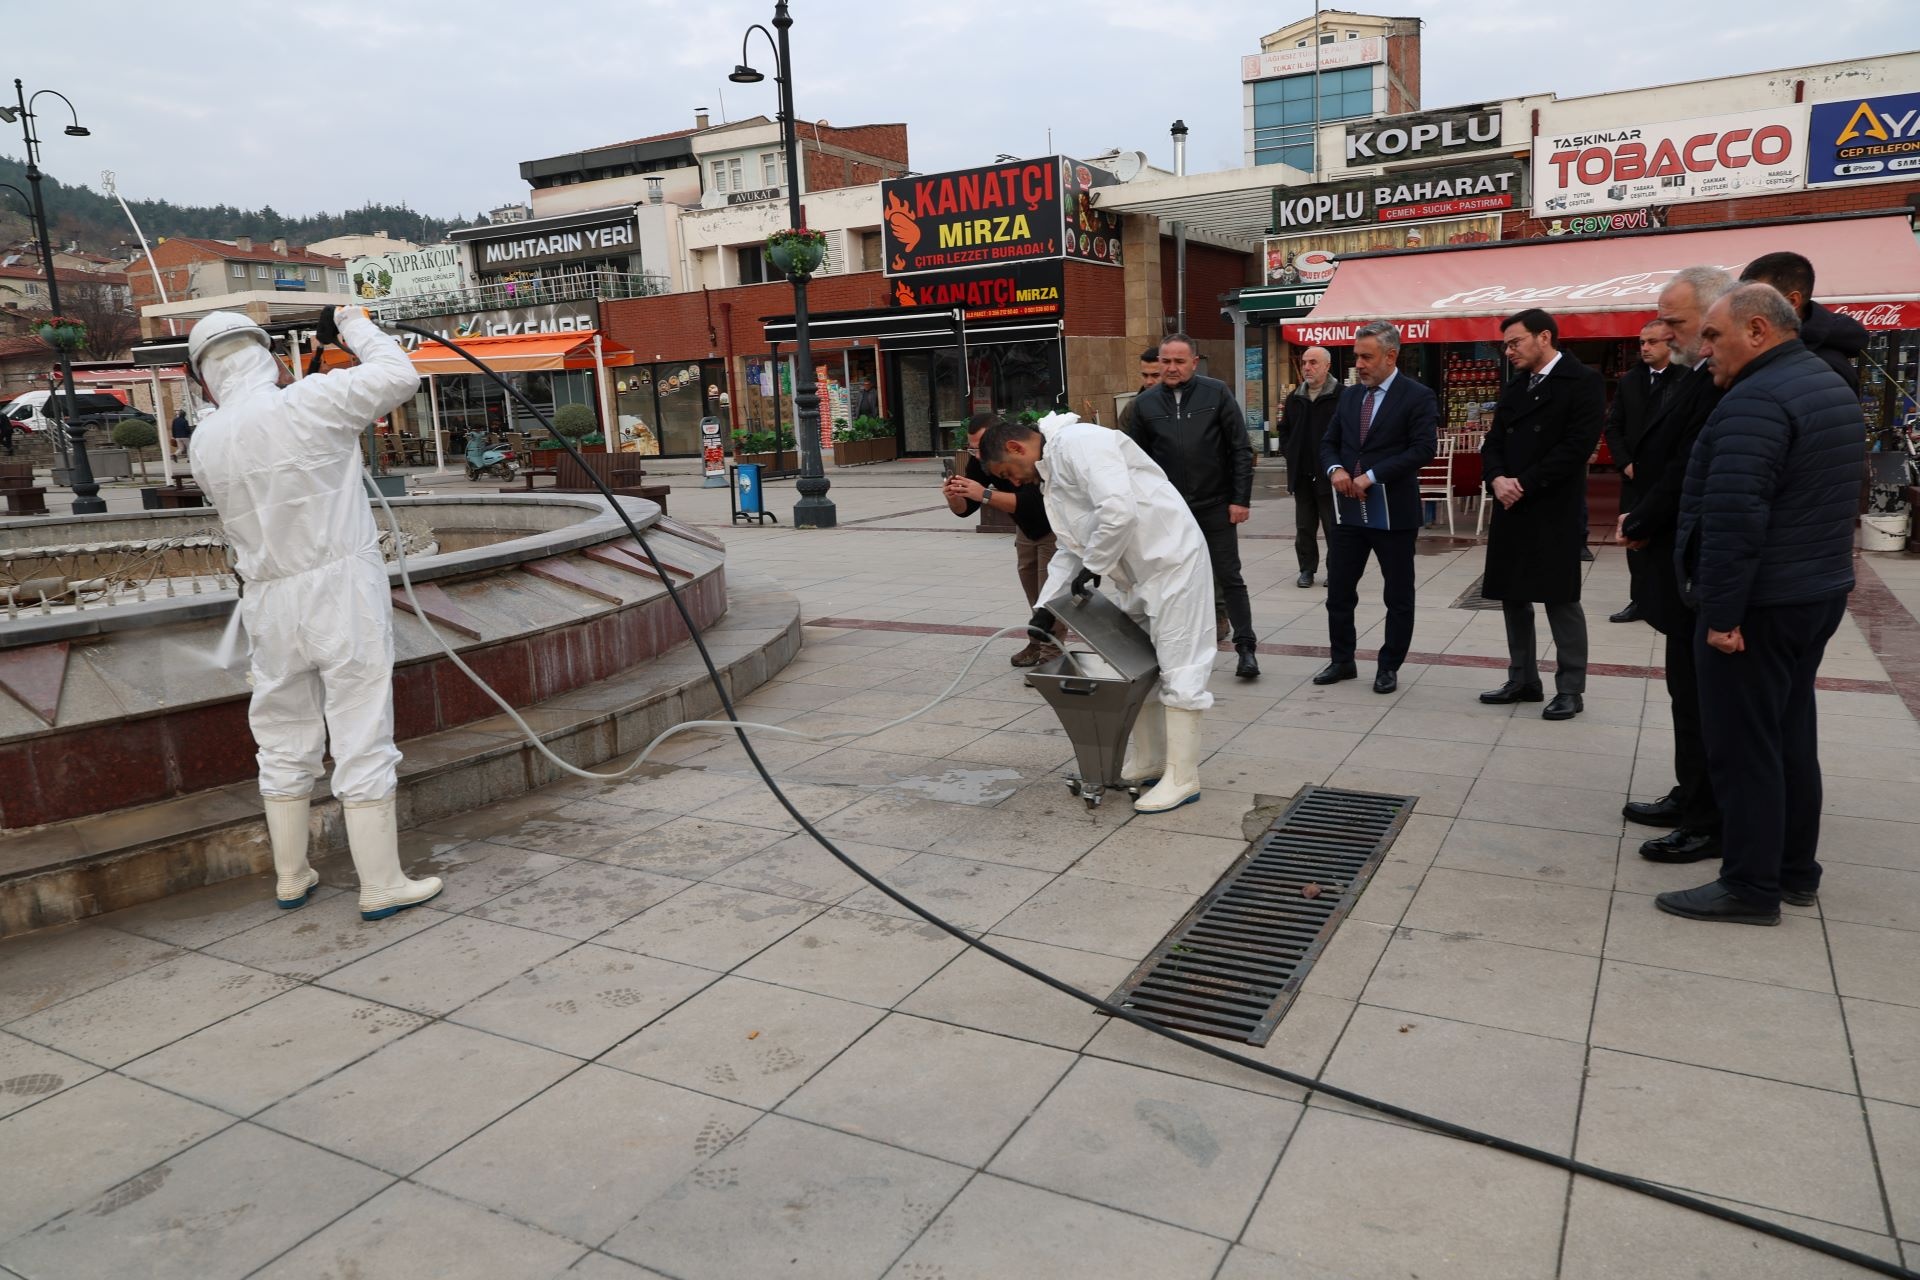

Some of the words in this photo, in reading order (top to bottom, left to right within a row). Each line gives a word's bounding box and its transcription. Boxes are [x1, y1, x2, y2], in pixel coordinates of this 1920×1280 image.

[1273, 63, 1295, 73] TOKAT
[1346, 114, 1501, 160] KOPLU
[1553, 129, 1642, 150] TAŞKINLAR
[1549, 124, 1792, 189] TOBACCO
[1840, 147, 1864, 158] CEP
[735, 190, 772, 203] AVUKAT
[914, 162, 1053, 218] KANATÇI
[1375, 172, 1514, 206] BAHARAT
[1279, 190, 1363, 227] KOPLU
[1386, 207, 1416, 219] ÇEMEN
[1423, 203, 1453, 213] SUCUK
[1459, 198, 1504, 210] PASTIRMA
[486, 231, 583, 264] MUHTARIN
[585, 218, 633, 249] YERİ
[388, 248, 456, 274] YAPRAKÇIM
[914, 253, 945, 269] ÇITIR
[947, 248, 989, 265] LEZZET
[991, 244, 1044, 261] BURADA!
[919, 278, 1016, 308] KANATÇI
[1295, 293, 1323, 307] KOP
[1297, 325, 1361, 345] TAŞKINLA
[1407, 320, 1430, 338] EVİ
